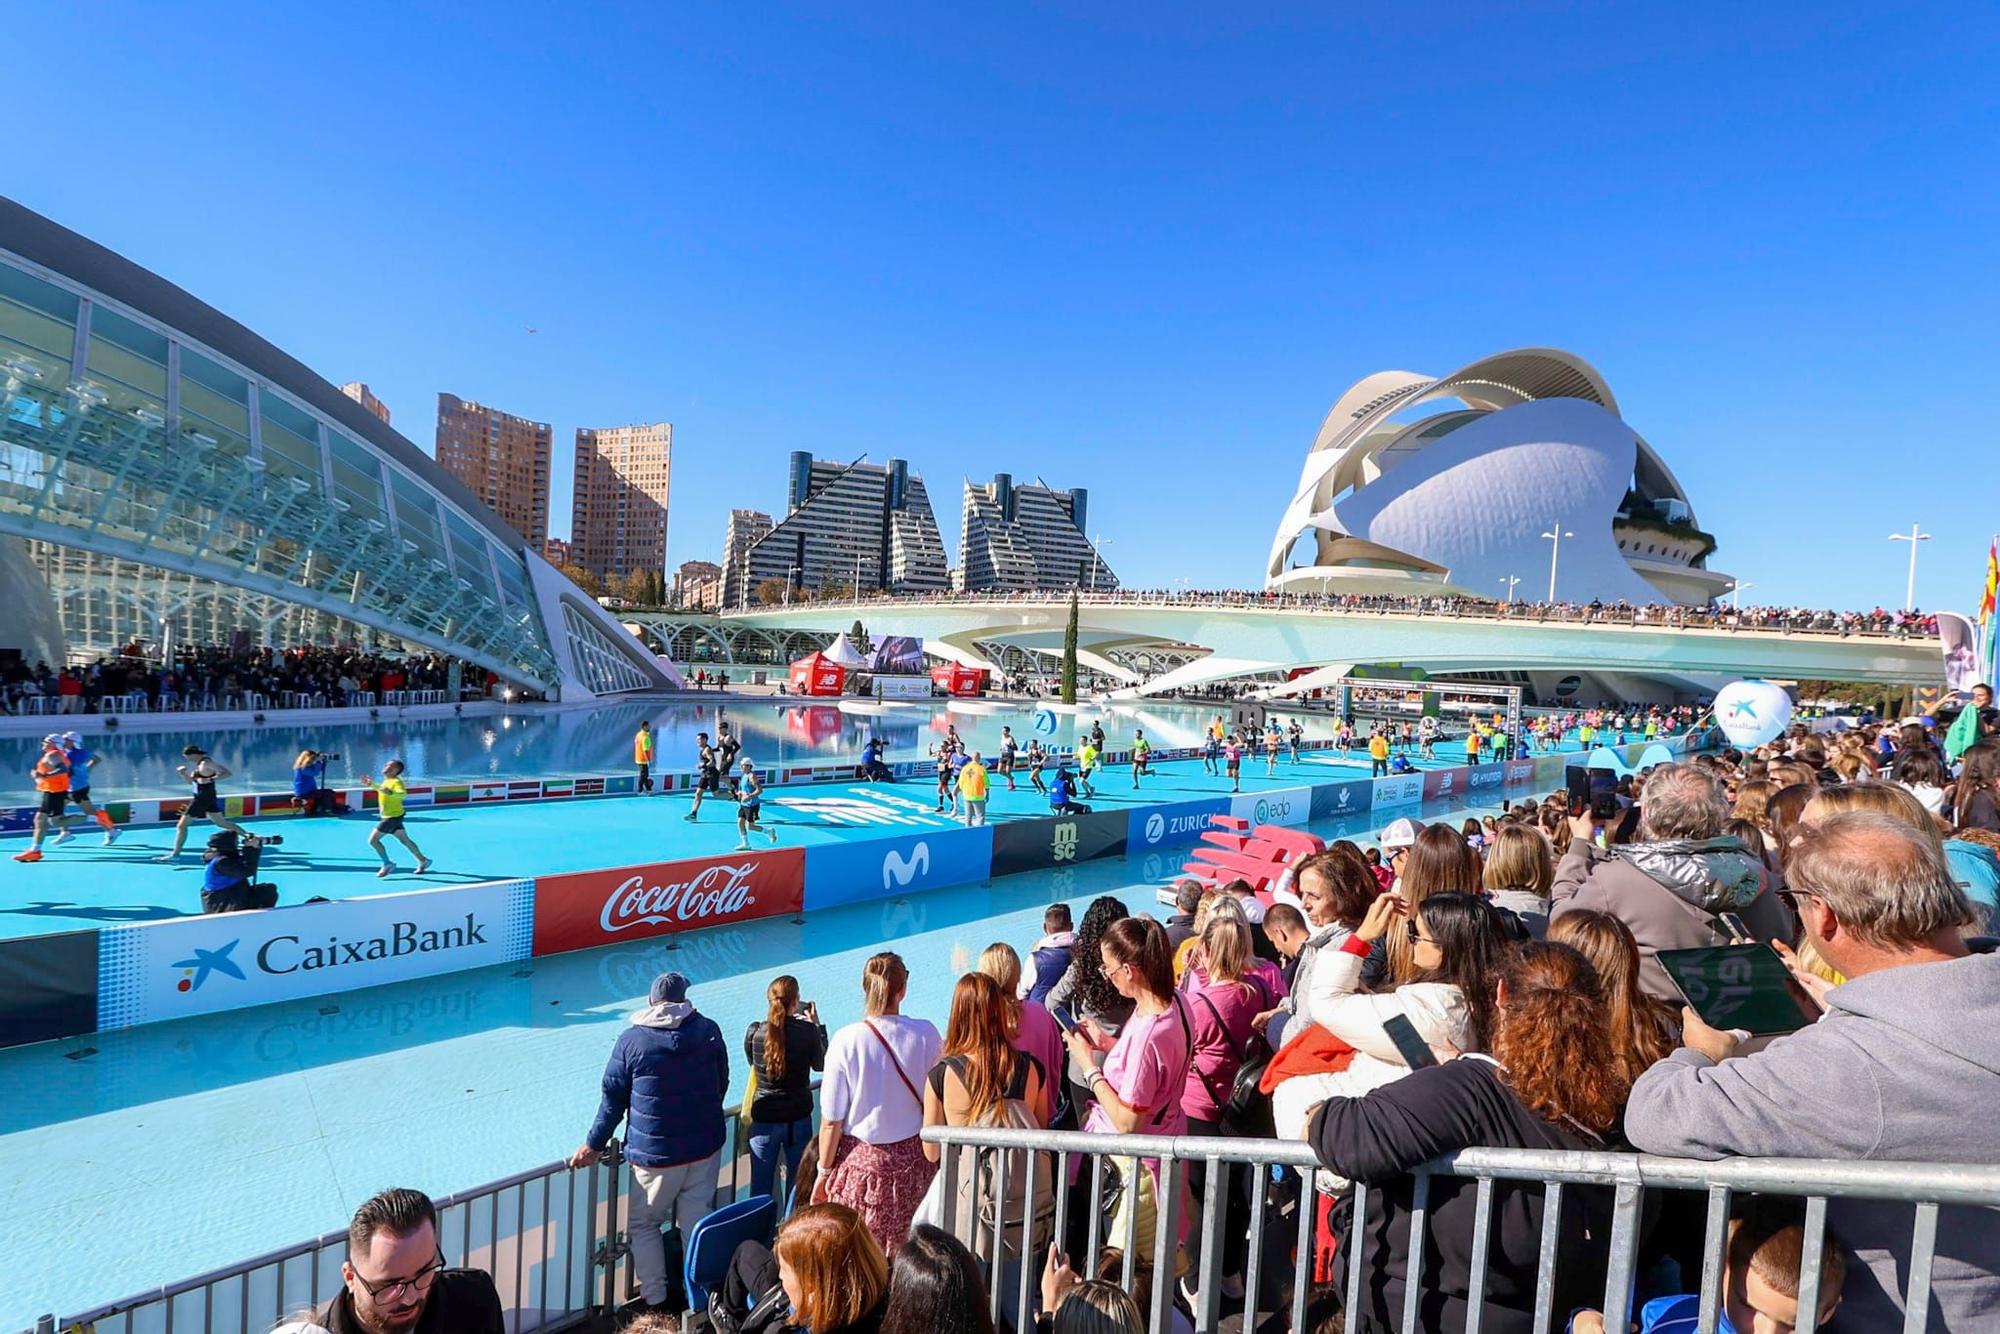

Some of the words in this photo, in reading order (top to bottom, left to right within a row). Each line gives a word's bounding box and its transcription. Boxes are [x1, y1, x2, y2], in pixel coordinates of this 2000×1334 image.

[1169, 812, 1217, 834] ZURICH
[1269, 796, 1291, 820] edp
[600, 861, 760, 932] Coca-Cola
[256, 912, 488, 975] CaixaBank
